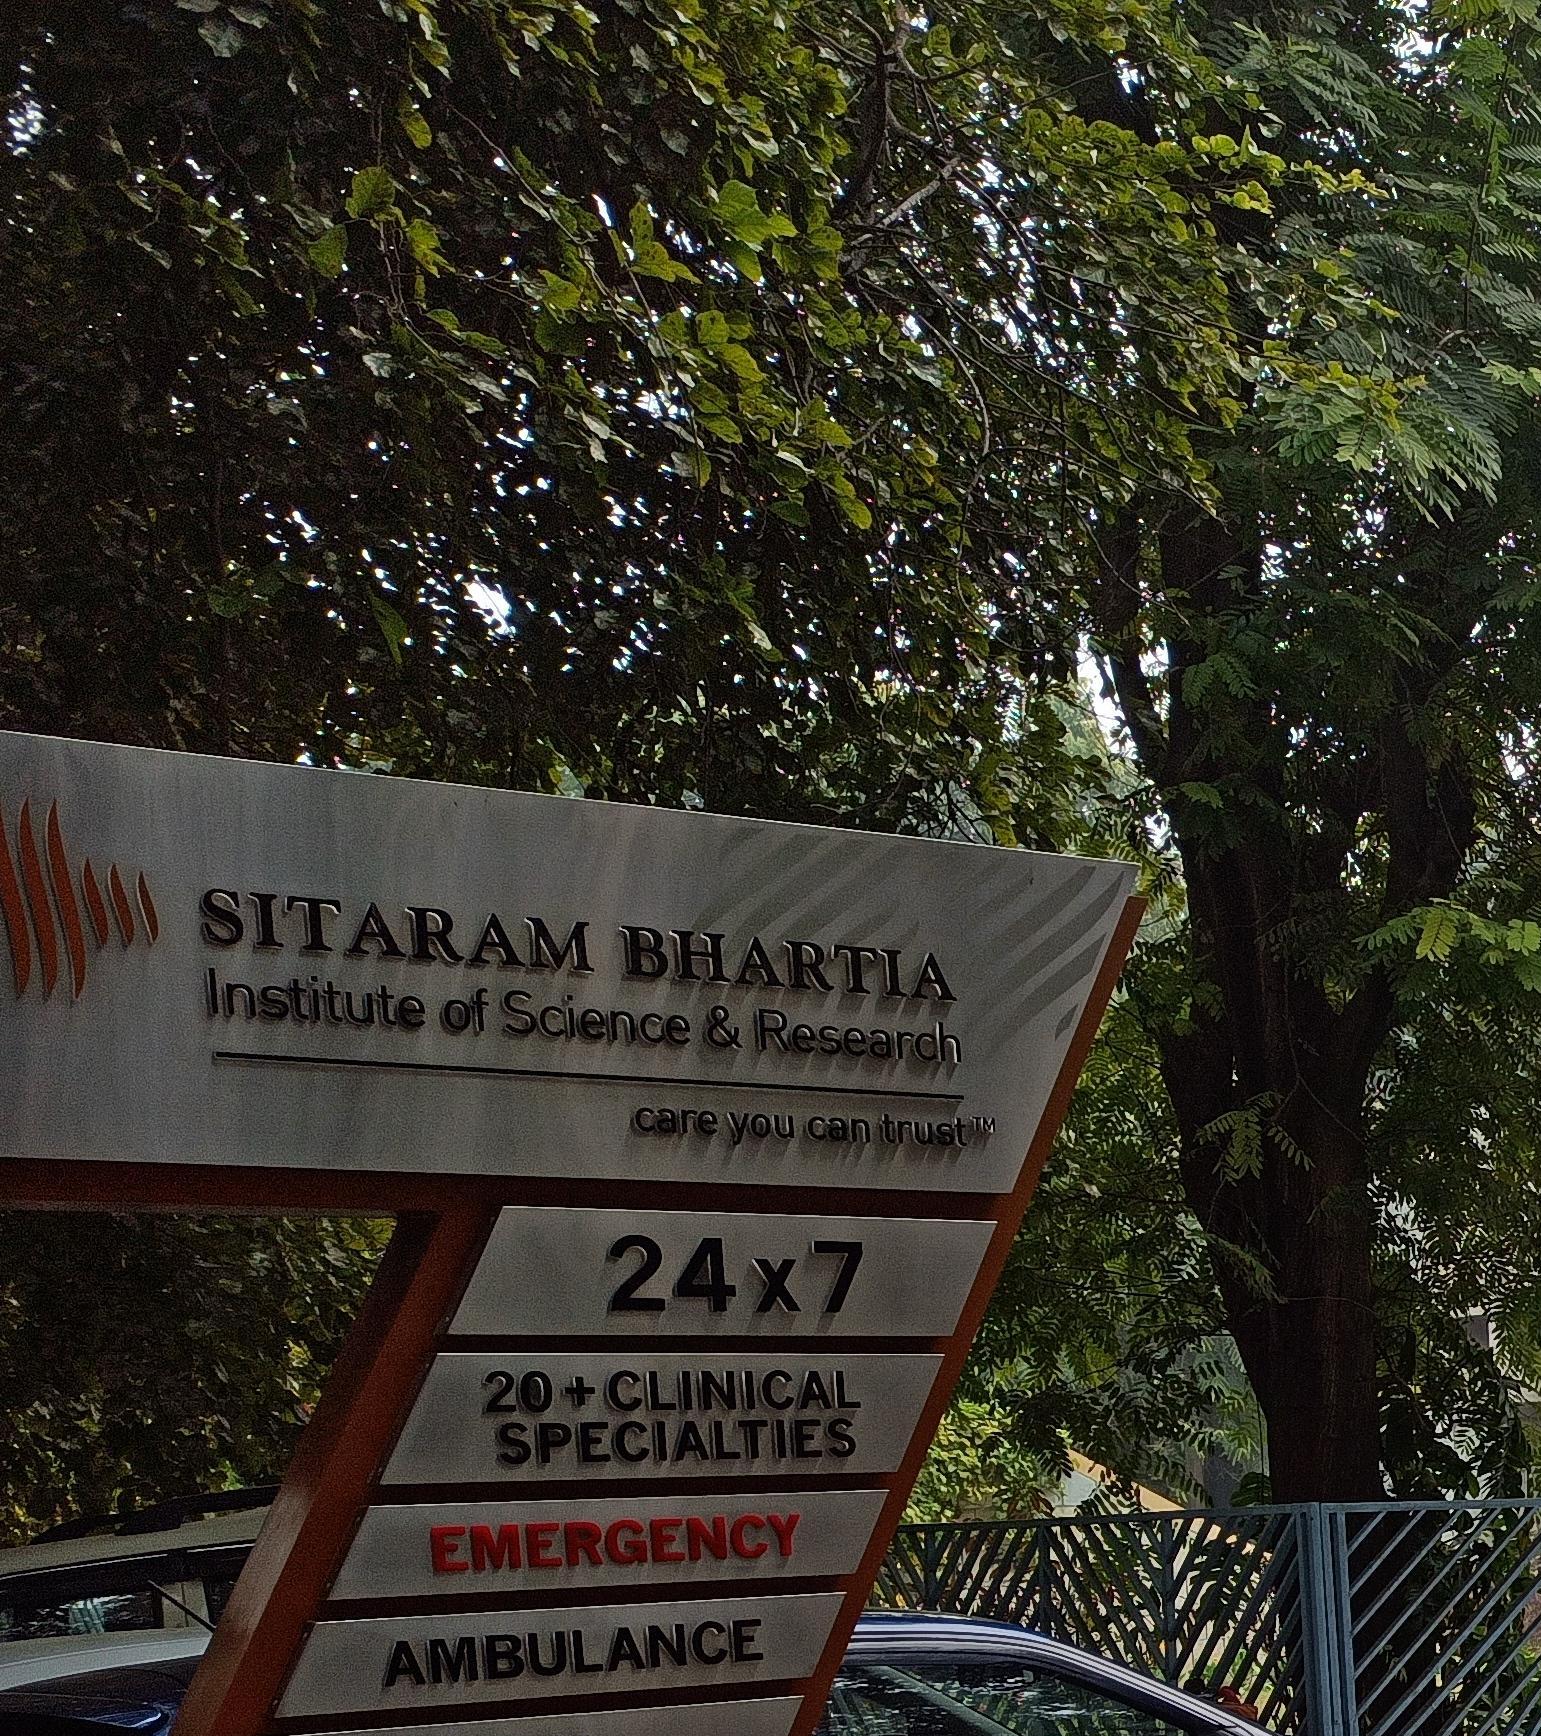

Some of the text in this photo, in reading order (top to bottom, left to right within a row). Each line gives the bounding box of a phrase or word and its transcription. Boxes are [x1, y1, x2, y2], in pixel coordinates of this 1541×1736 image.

[201, 887, 958, 1002] SITARAM BHARTIA
[206, 966, 963, 1064] Institute of Science & Research
[633, 1105, 718, 1137] care
[726, 1109, 796, 1146] you
[806, 1114, 871, 1144] can
[605, 1368, 863, 1413] CLINICAL
[498, 1417, 858, 1466] SPECIALTIES
[429, 1513, 801, 1576] EMERGENCY
[382, 1618, 764, 1689] AMBULANCE
